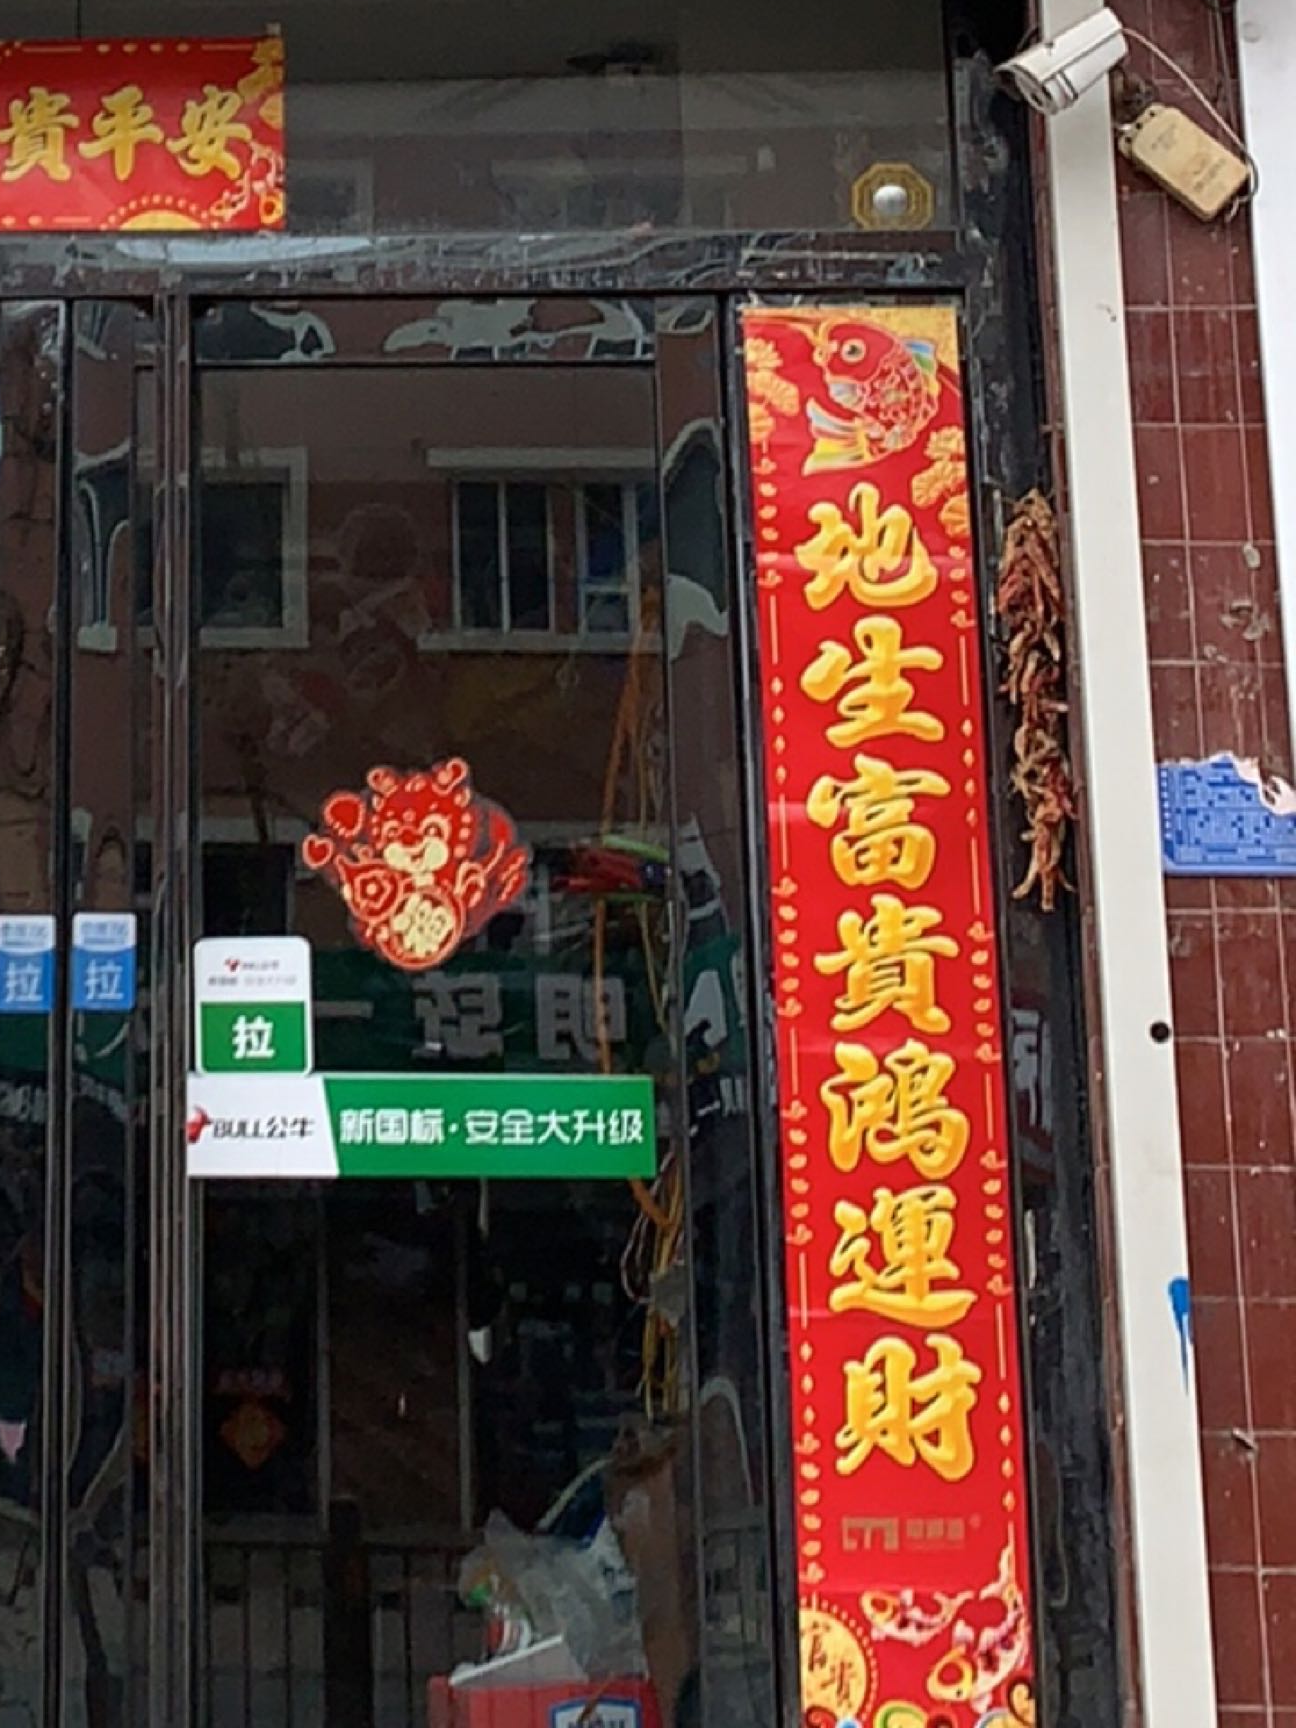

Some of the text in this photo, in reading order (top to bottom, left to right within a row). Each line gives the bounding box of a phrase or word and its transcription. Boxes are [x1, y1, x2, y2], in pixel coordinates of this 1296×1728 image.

[5, 960, 44, 1003] 拉
[85, 958, 125, 1001] 拉
[793, 481, 983, 1482] 地生富貴鴻運財
[231, 1014, 277, 1060] 拉
